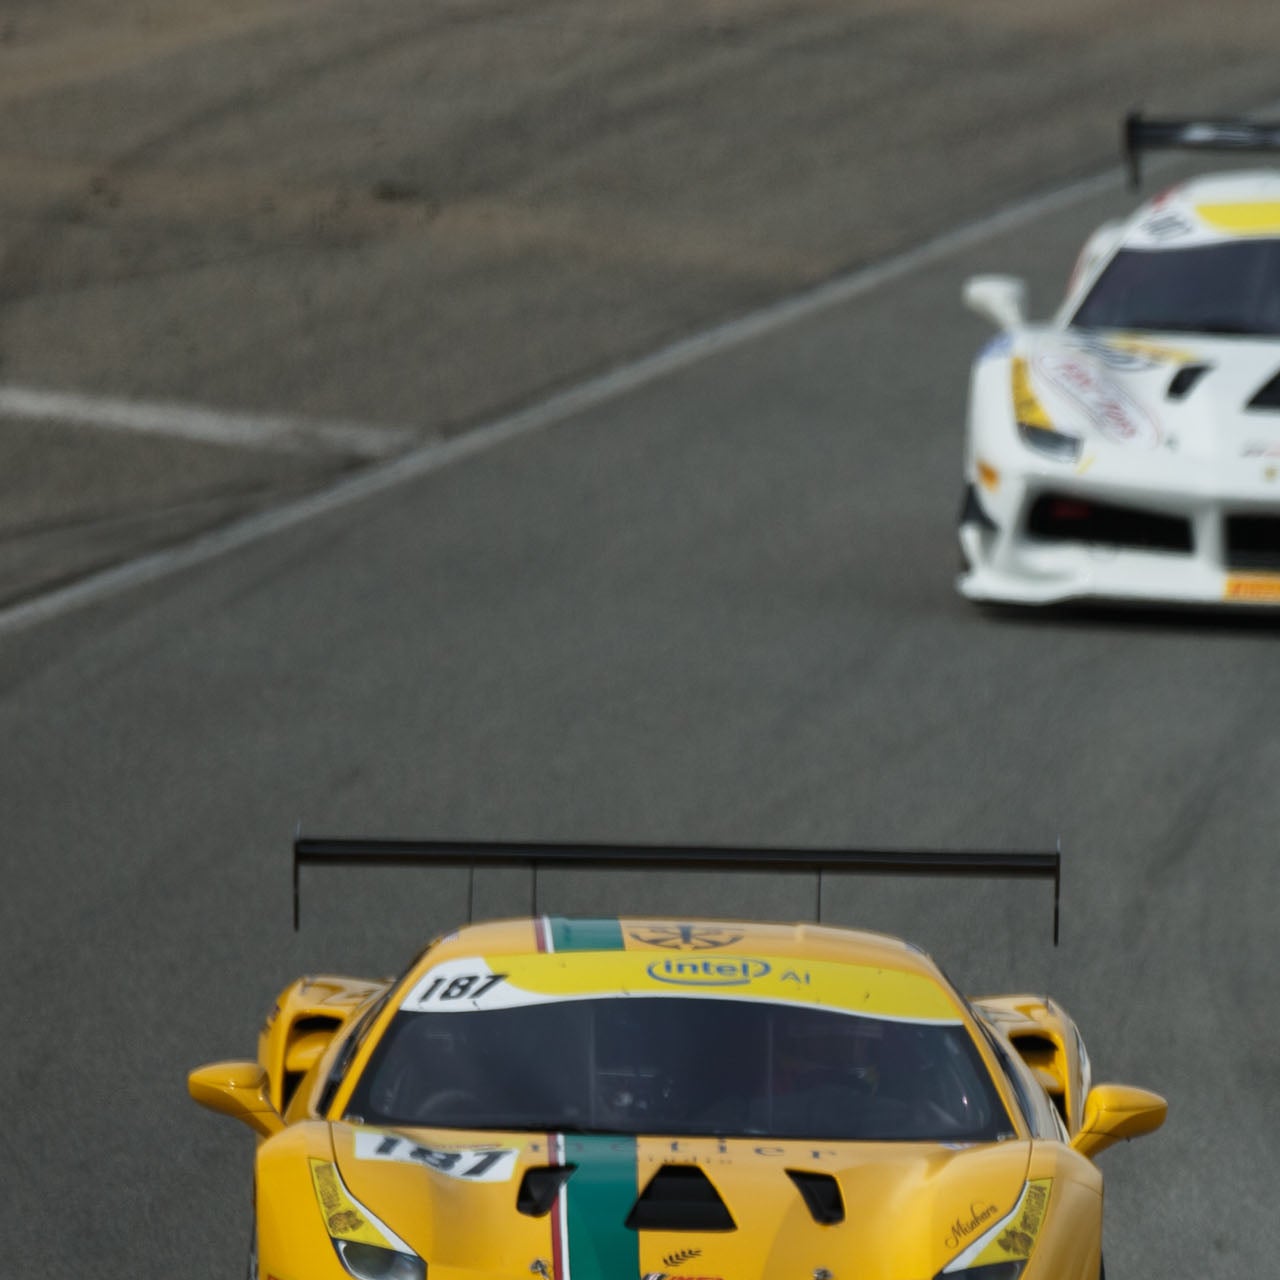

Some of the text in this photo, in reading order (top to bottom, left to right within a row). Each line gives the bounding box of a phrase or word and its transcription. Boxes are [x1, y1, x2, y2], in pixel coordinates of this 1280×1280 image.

[663, 958, 811, 985] intel AI
[421, 974, 508, 1001] 187
[375, 1136, 513, 1177] 187
